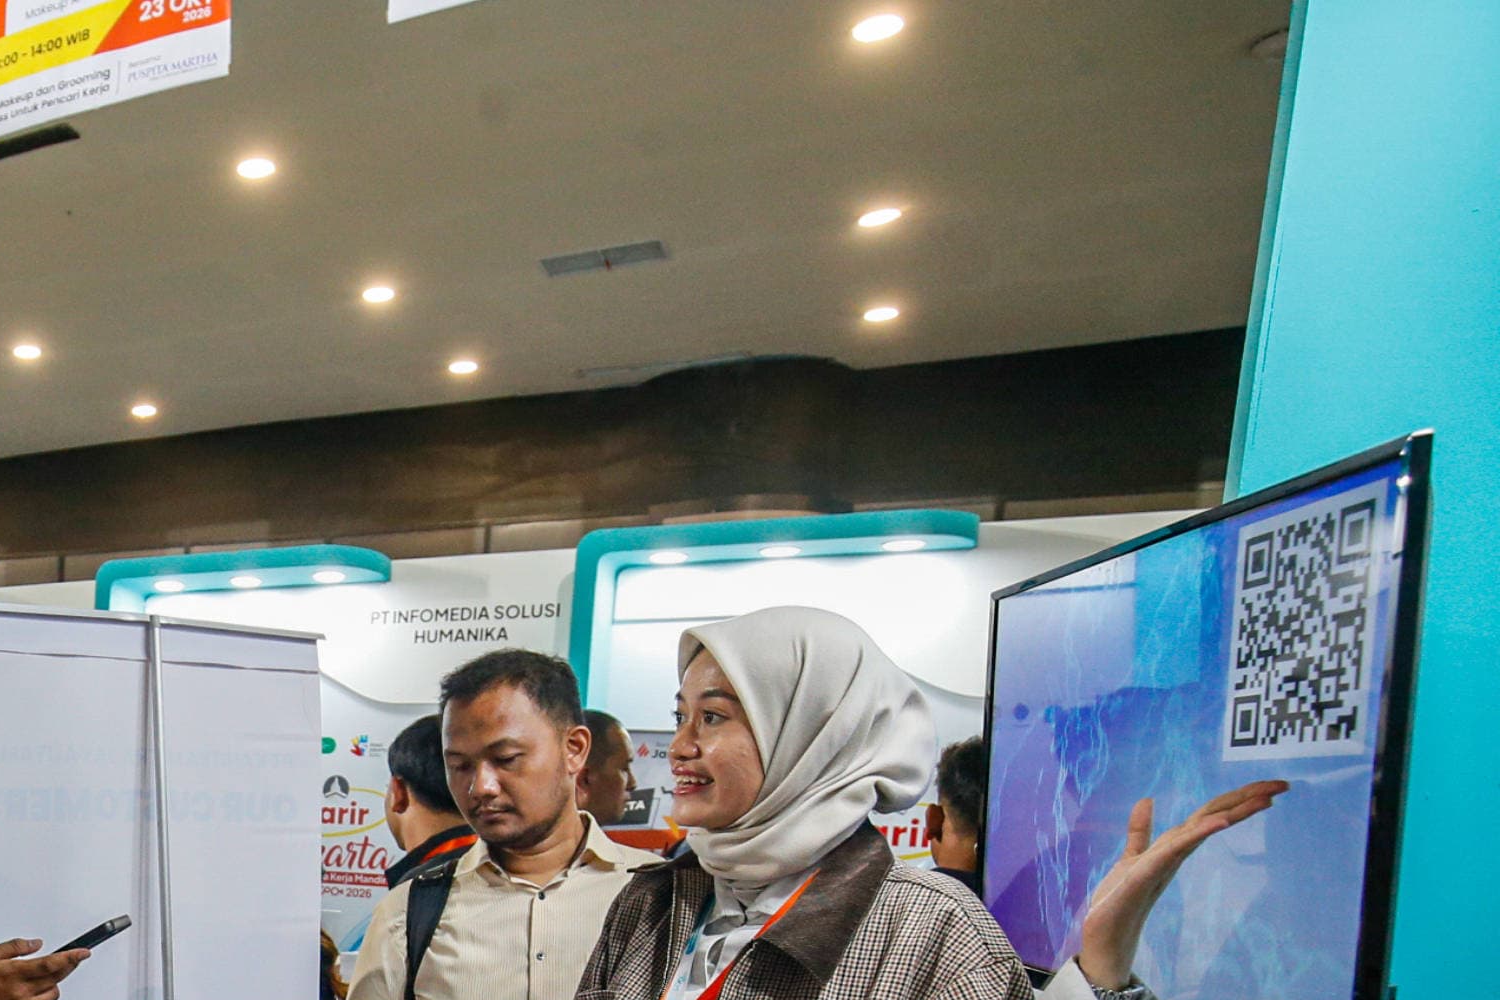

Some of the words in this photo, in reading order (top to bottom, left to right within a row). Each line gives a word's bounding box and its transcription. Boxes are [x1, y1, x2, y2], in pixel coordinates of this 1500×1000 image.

[139, 0, 164, 22] 23
[182, 6, 212, 22] 2026
[30, 39, 63, 57] 14:00
[66, 28, 90, 46] WIB
[127, 62, 170, 83] PUSPITA
[171, 53, 219, 72] MARTHA
[35, 84, 56, 98] dan
[57, 69, 111, 92] Grooming
[41, 91, 81, 109] Pencari
[82, 83, 110, 98] Kerja
[370, 611, 389, 625] PT
[392, 604, 490, 624] INFOMEDIA
[493, 601, 561, 620] SOLUSI
[413, 627, 509, 644] HUMANIKA
[321, 800, 370, 826] arir
[624, 799, 646, 812] TA
[321, 835, 395, 871] arta
[330, 872, 354, 884] Kerja
[346, 887, 372, 898] 2026
